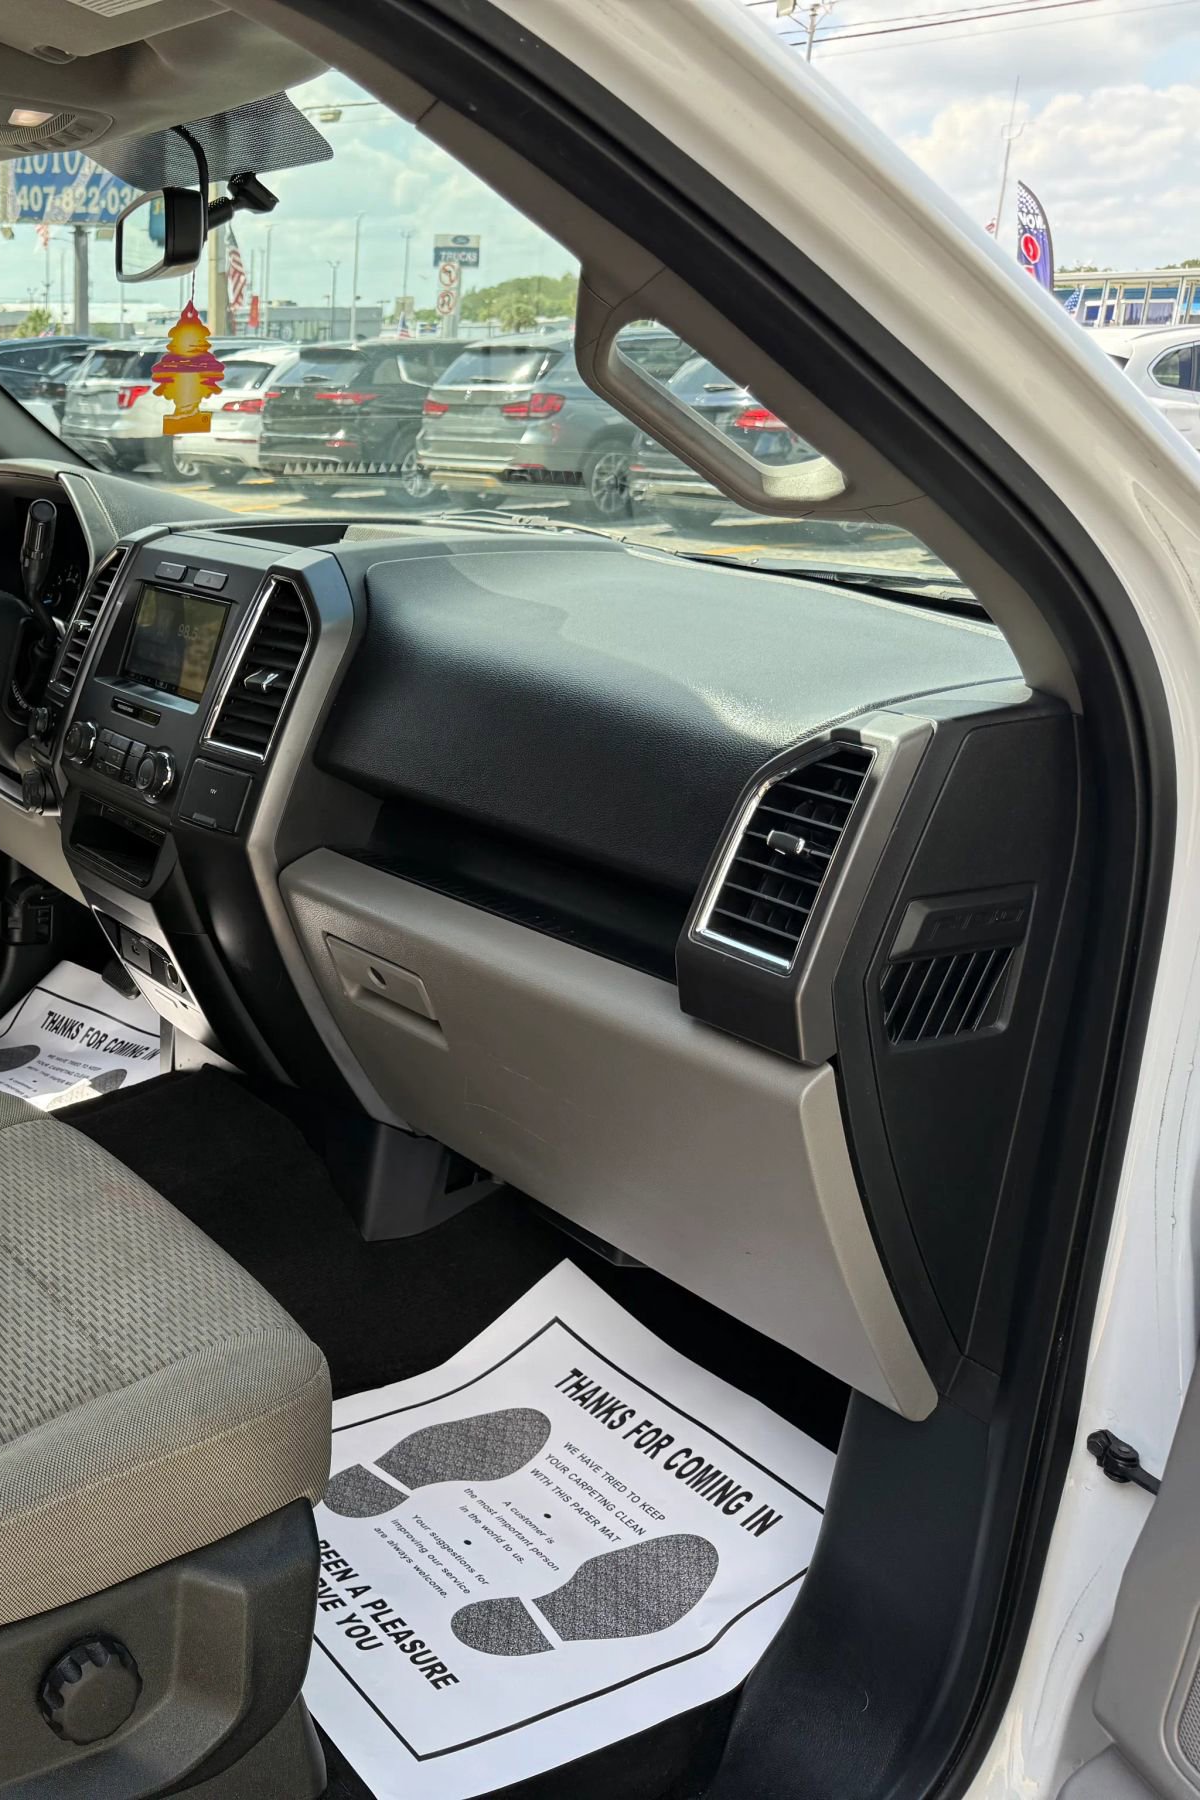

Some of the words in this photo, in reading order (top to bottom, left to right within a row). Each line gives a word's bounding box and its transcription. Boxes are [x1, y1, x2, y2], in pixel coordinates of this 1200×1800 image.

[177, 623, 200, 641] 98.5
[40, 1010, 85, 1040] THANKS
[79, 1026, 109, 1050] FOR
[102, 1037, 150, 1059] COMING
[140, 1047, 160, 1061] IN
[554, 1367, 636, 1430] THANKS
[622, 1419, 675, 1460] FOR
[663, 1447, 753, 1515] COMING
[739, 1503, 784, 1538] IN
[563, 1441, 580, 1455] WE
[577, 1453, 603, 1474] HAVE
[601, 1471, 628, 1493] TRIED
[626, 1490, 641, 1504] TO
[639, 1501, 666, 1522] KEEP
[464, 1487, 477, 1499] the
[476, 1500, 498, 1515] most
[495, 1515, 534, 1547] important
[529, 1545, 560, 1572] person
[510, 1506, 547, 1537] customer
[545, 1536, 555, 1545] is
[530, 1468, 553, 1487] WITH
[551, 1485, 572, 1503] THIS
[569, 1502, 601, 1527] PAPER
[598, 1526, 622, 1543] MAT
[545, 1453, 570, 1474] YOUR
[568, 1472, 616, 1512] CARPETING
[614, 1510, 647, 1536] CLEAN
[373, 1526, 388, 1539] are
[386, 1539, 414, 1564] always
[413, 1564, 448, 1599] welcome.
[391, 1518, 429, 1554] improving
[427, 1553, 444, 1567] our
[441, 1566, 471, 1595] service
[412, 1514, 431, 1531] Your
[429, 1531, 476, 1574] suggestions
[474, 1573, 490, 1586] for
[458, 1504, 469, 1513] in
[467, 1513, 482, 1524] the
[481, 1524, 506, 1544] world
[502, 1543, 513, 1552] to
[512, 1552, 525, 1565] us.
[335, 1612, 384, 1651] YOU
[344, 1585, 372, 1599] A
[360, 1598, 460, 1691] PLEASURE
